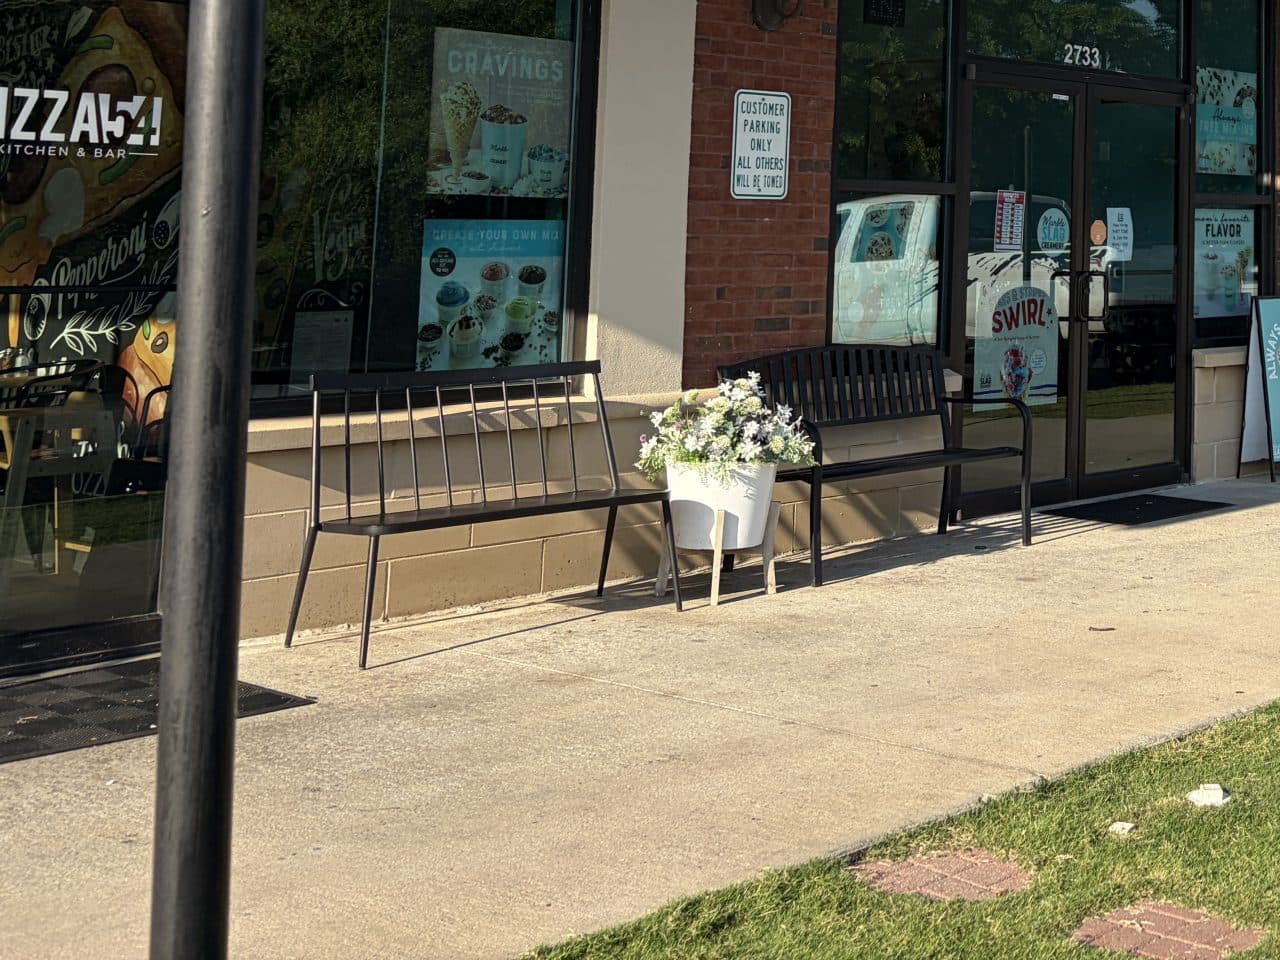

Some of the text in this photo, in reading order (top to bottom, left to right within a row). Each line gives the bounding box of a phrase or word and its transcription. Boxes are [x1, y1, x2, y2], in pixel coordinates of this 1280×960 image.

[1063, 43, 1100, 67] 2733
[447, 49, 563, 82] CRAVINGS
[741, 101, 785, 116] CUSTOMER
[743, 119, 781, 134] PARKING
[750, 138, 772, 152] ONLY
[76, 147, 86, 157] &
[94, 147, 126, 159] BAR
[737, 156, 784, 171] ALL OTHERS
[736, 174, 783, 189] WILL BE TOWED
[479, 229, 508, 240] YOUR
[512, 229, 537, 240] OWN
[1042, 225, 1066, 241] SLAB
[1205, 223, 1241, 238] FLAVOR
[992, 298, 1047, 333] SWIRL
